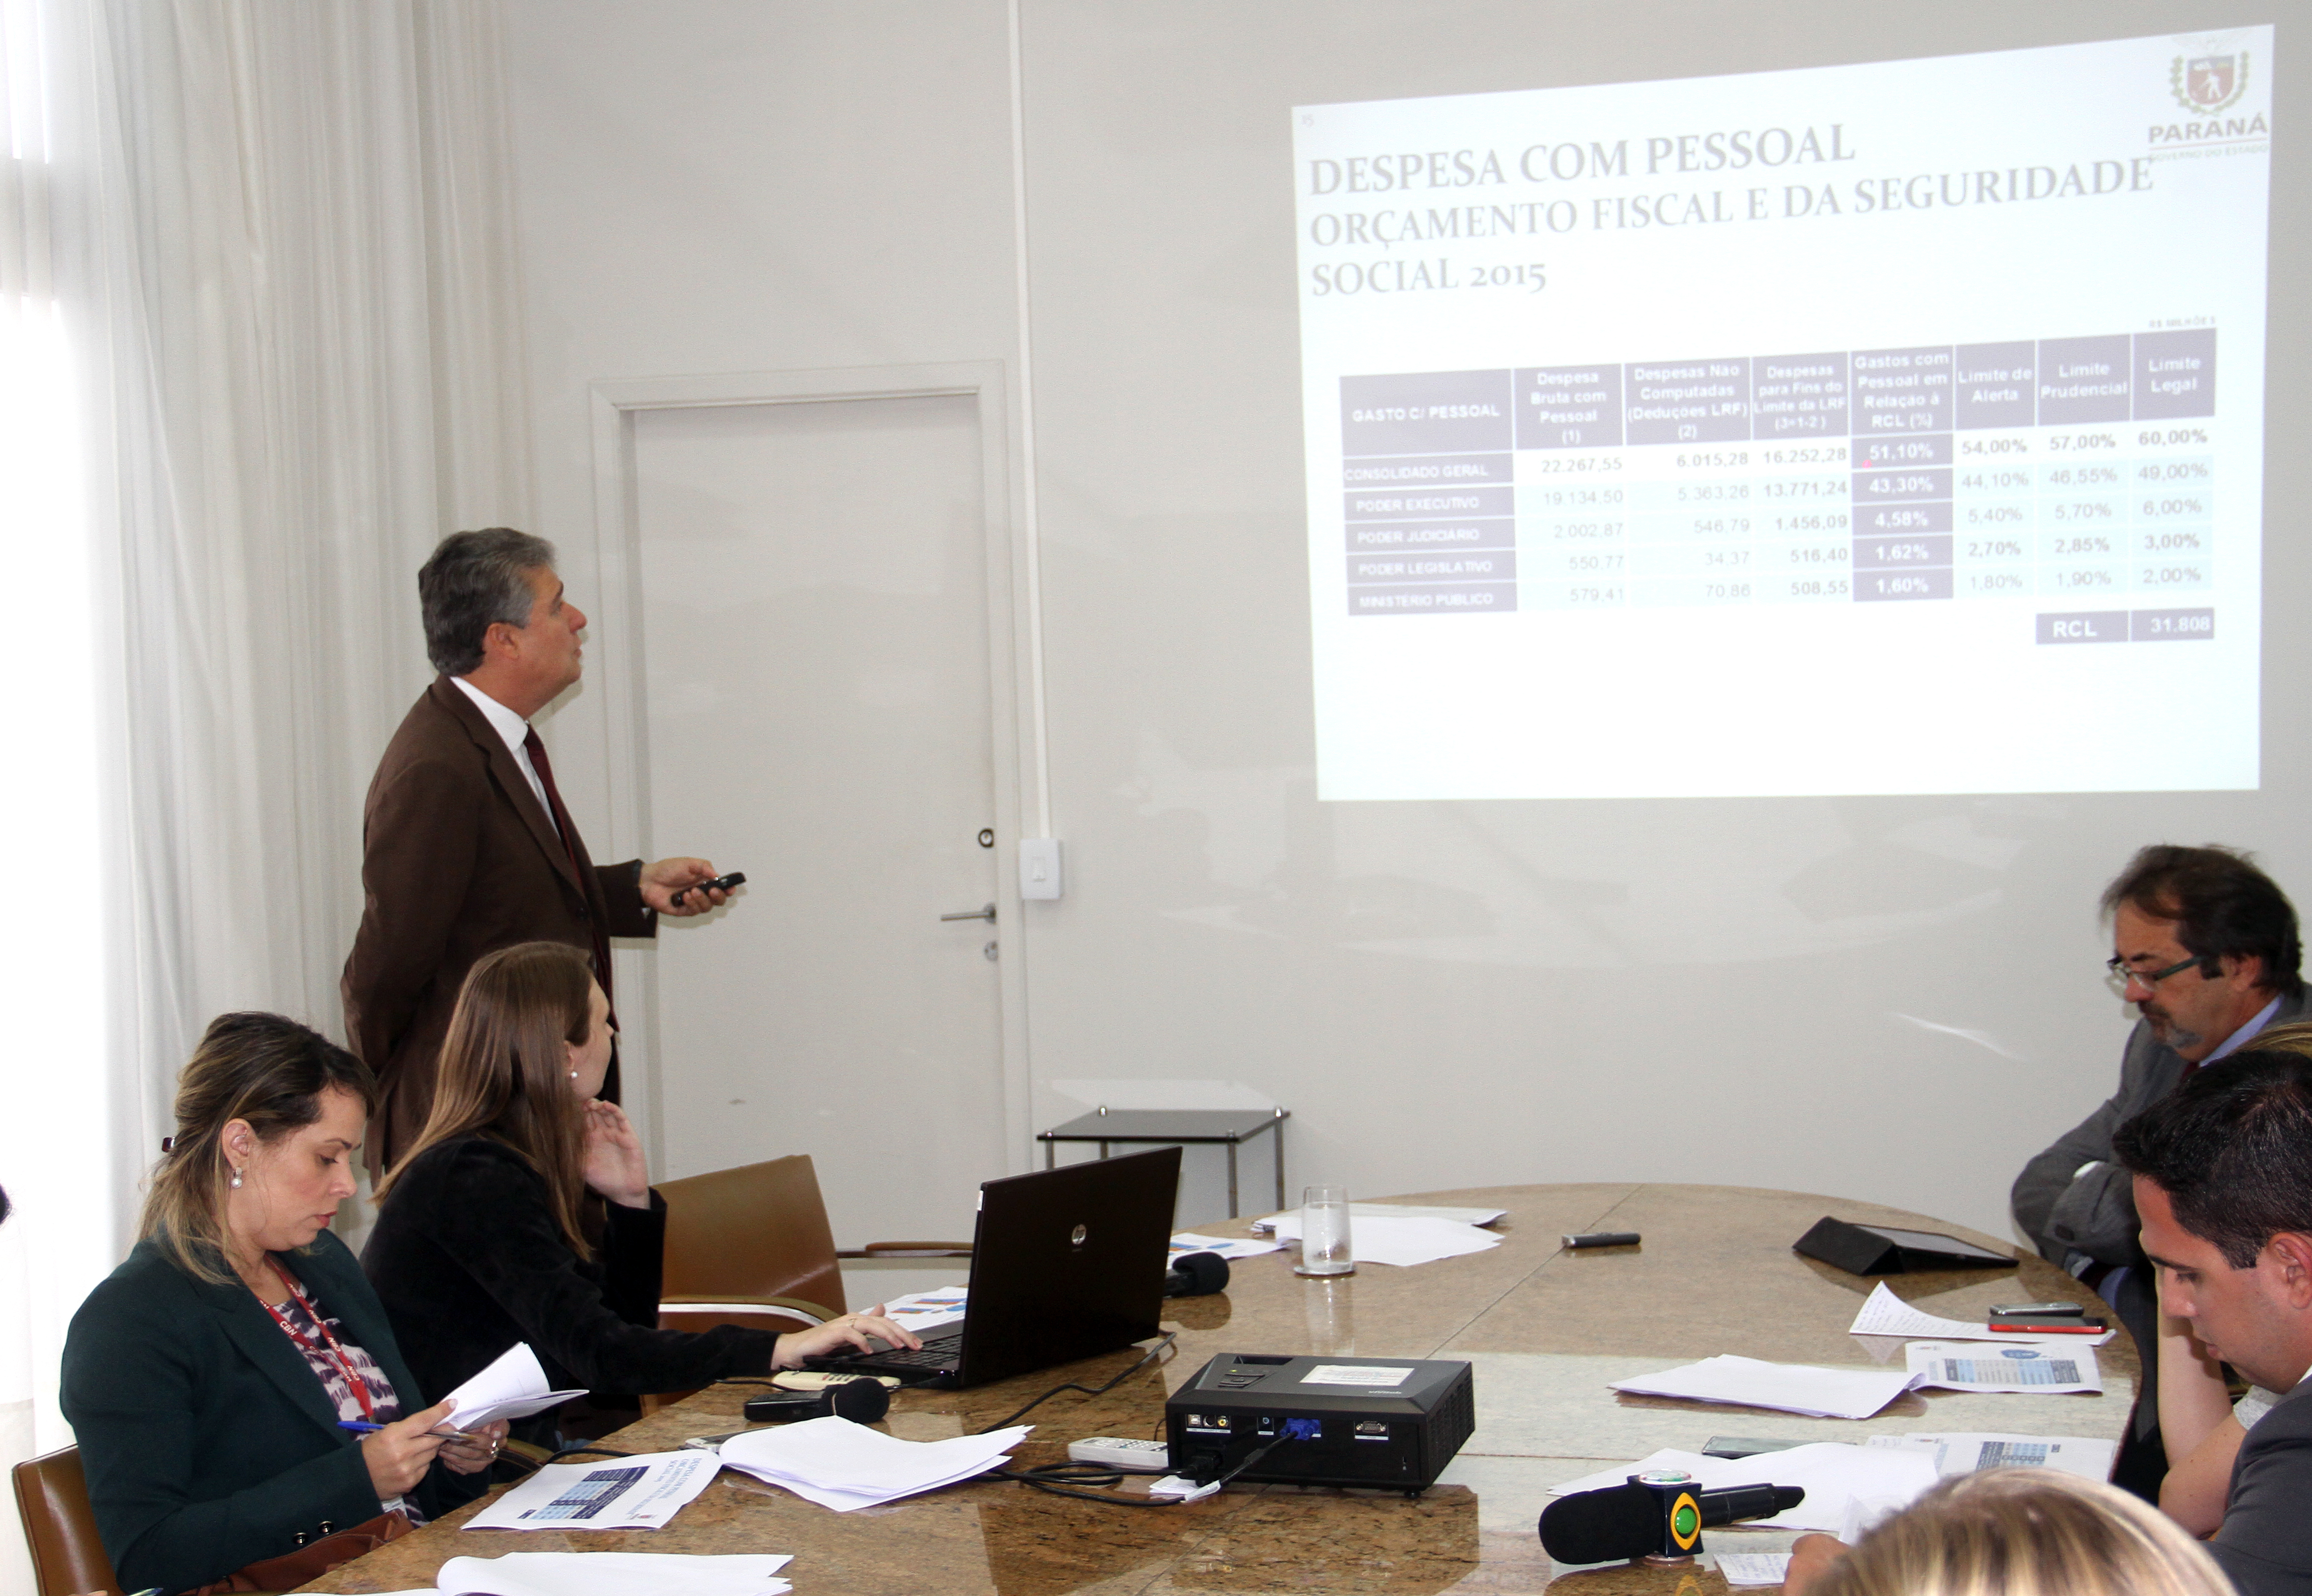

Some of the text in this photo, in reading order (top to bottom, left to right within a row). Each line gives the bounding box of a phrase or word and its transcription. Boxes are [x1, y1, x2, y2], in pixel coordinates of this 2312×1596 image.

[2148, 112, 2268, 143] PARANÁ
[1310, 123, 1855, 195] DESPESA COM PESSOAL
[1310, 157, 2154, 251] ORÇAMENTO FISCAL E DA SEGURIDADE
[1312, 258, 1547, 296] SOCIAL 2015
[1854, 353, 1950, 370] Gastos com
[2149, 357, 2202, 372] Limite
[1634, 367, 1705, 382] Despesas
[1767, 365, 1834, 380] Despesas
[1958, 367, 2032, 384] Limite de
[2058, 363, 2110, 378] Limite
[1537, 372, 1599, 387] Despesa
[1857, 373, 1948, 389] Pessoal em
[2151, 377, 2198, 395] Legal
[1531, 391, 1606, 405] Bruta com
[1640, 384, 1735, 401] Computadas
[1759, 385, 1789, 397] para
[1971, 389, 2019, 403] Alerta
[2041, 381, 2128, 399] Prudencial
[1352, 408, 1405, 422] GASTO
[1429, 404, 1500, 419] PESSOAL
[1799, 399, 1816, 411] da
[1540, 410, 1597, 424] Pessoal
[1871, 414, 1905, 428] RCL
[1562, 430, 1580, 444] (1)
[1678, 424, 1697, 441] (2)
[2138, 428, 2208, 447] 60,00%
[1869, 442, 1934, 460] 51,10%
[1962, 438, 2028, 455] 54,00%
[2050, 433, 2117, 452] 57,00%
[1676, 452, 1749, 468] 6.015,28
[1763, 447, 1847, 464] 16.252,28
[1344, 465, 1488, 480] CONSOLIDADO GERAL
[1541, 457, 1623, 474] 22.267,55
[2138, 462, 2209, 482] 49,00%
[1961, 472, 2029, 490] 44,10%
[2049, 467, 2118, 486] 46,55%
[1764, 480, 1847, 498] 13.771,24
[1869, 477, 1934, 494] 43,30%
[1357, 496, 1480, 512] PODER EXECUTIVO
[2055, 502, 2112, 521] 5,70%
[2143, 498, 2203, 517] 6,00%
[1776, 515, 1848, 531] 1.456,09
[1875, 511, 1929, 528] 4,58%
[1968, 507, 2023, 525] 5,40%
[1358, 531, 1403, 543] PODER
[2055, 536, 2110, 555] 2,85%
[2145, 533, 2201, 552] 3,00%
[1790, 547, 1848, 564] 516,40
[1876, 544, 1929, 561] 1,62%
[1967, 540, 2022, 558] 2,70%
[1358, 563, 1404, 576] PODER
[2144, 567, 2202, 585] 2,00%
[1876, 577, 1929, 594] 1,60%
[1970, 574, 2023, 591] 1,80%
[2057, 570, 2112, 588] 1,90%
[1790, 580, 1848, 596] 508,55
[2053, 620, 2097, 637] RCL
[2151, 616, 2211, 634] 31.808
[279, 1320, 298, 1336] CBN
